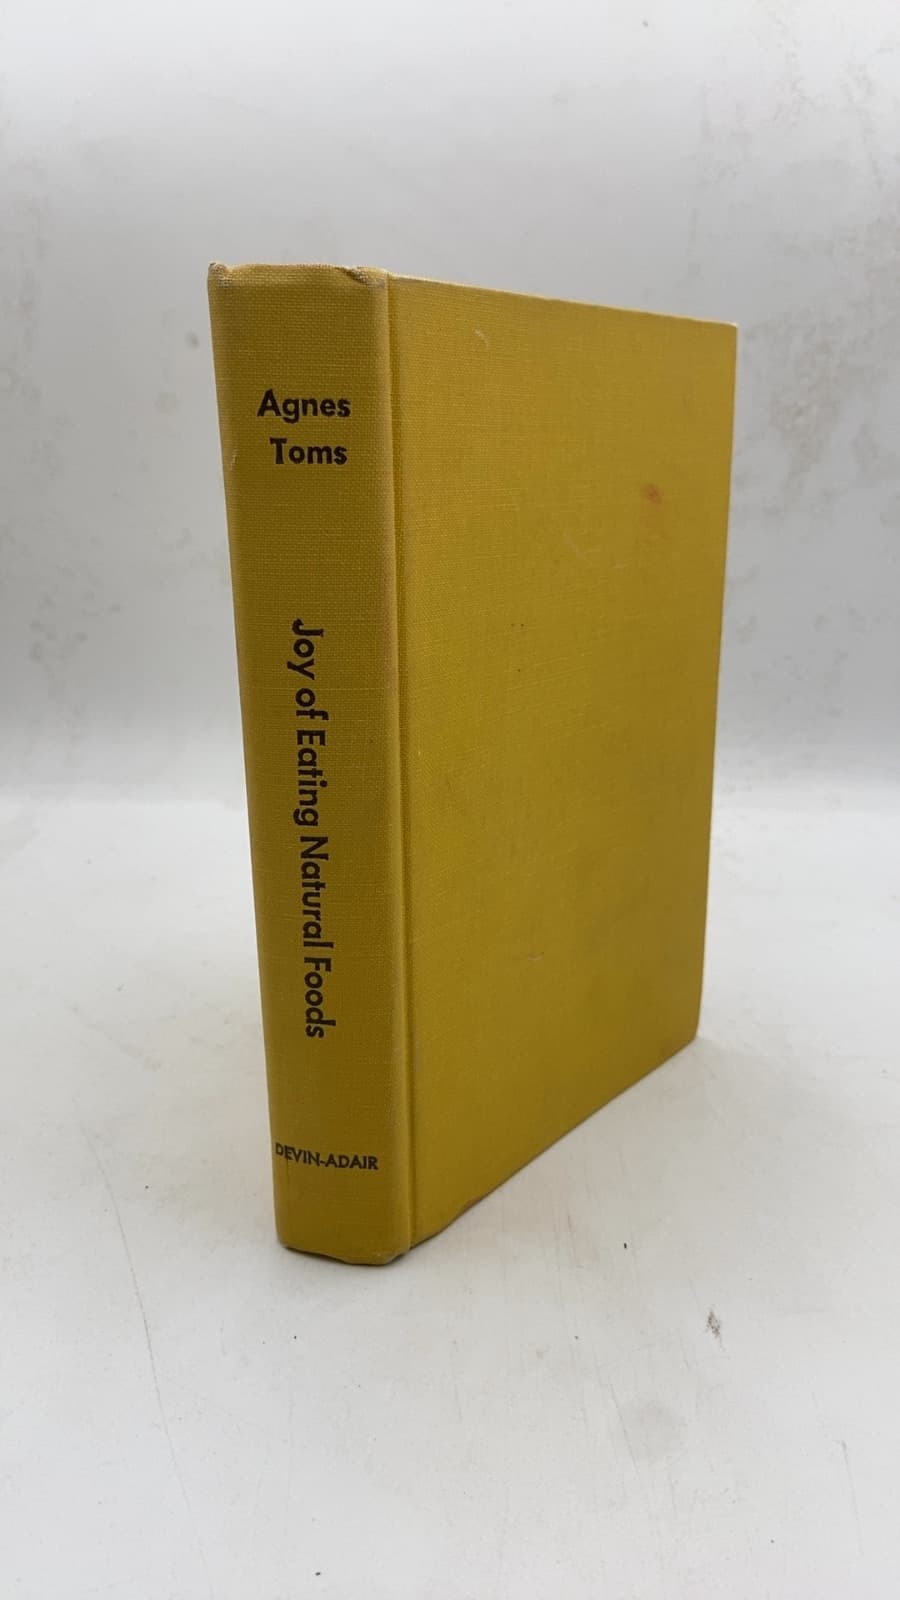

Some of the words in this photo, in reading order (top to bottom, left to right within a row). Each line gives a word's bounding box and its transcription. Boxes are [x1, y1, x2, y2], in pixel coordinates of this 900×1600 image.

[256, 387, 352, 424] Agnes
[269, 437, 348, 466] Toms
[286, 618, 325, 681] Joy
[295, 687, 329, 721] of
[293, 729, 328, 827] Eating
[300, 835, 335, 949] Natural
[304, 956, 337, 1039] Foods
[275, 1142, 379, 1170] DEVIN-ADAIR
